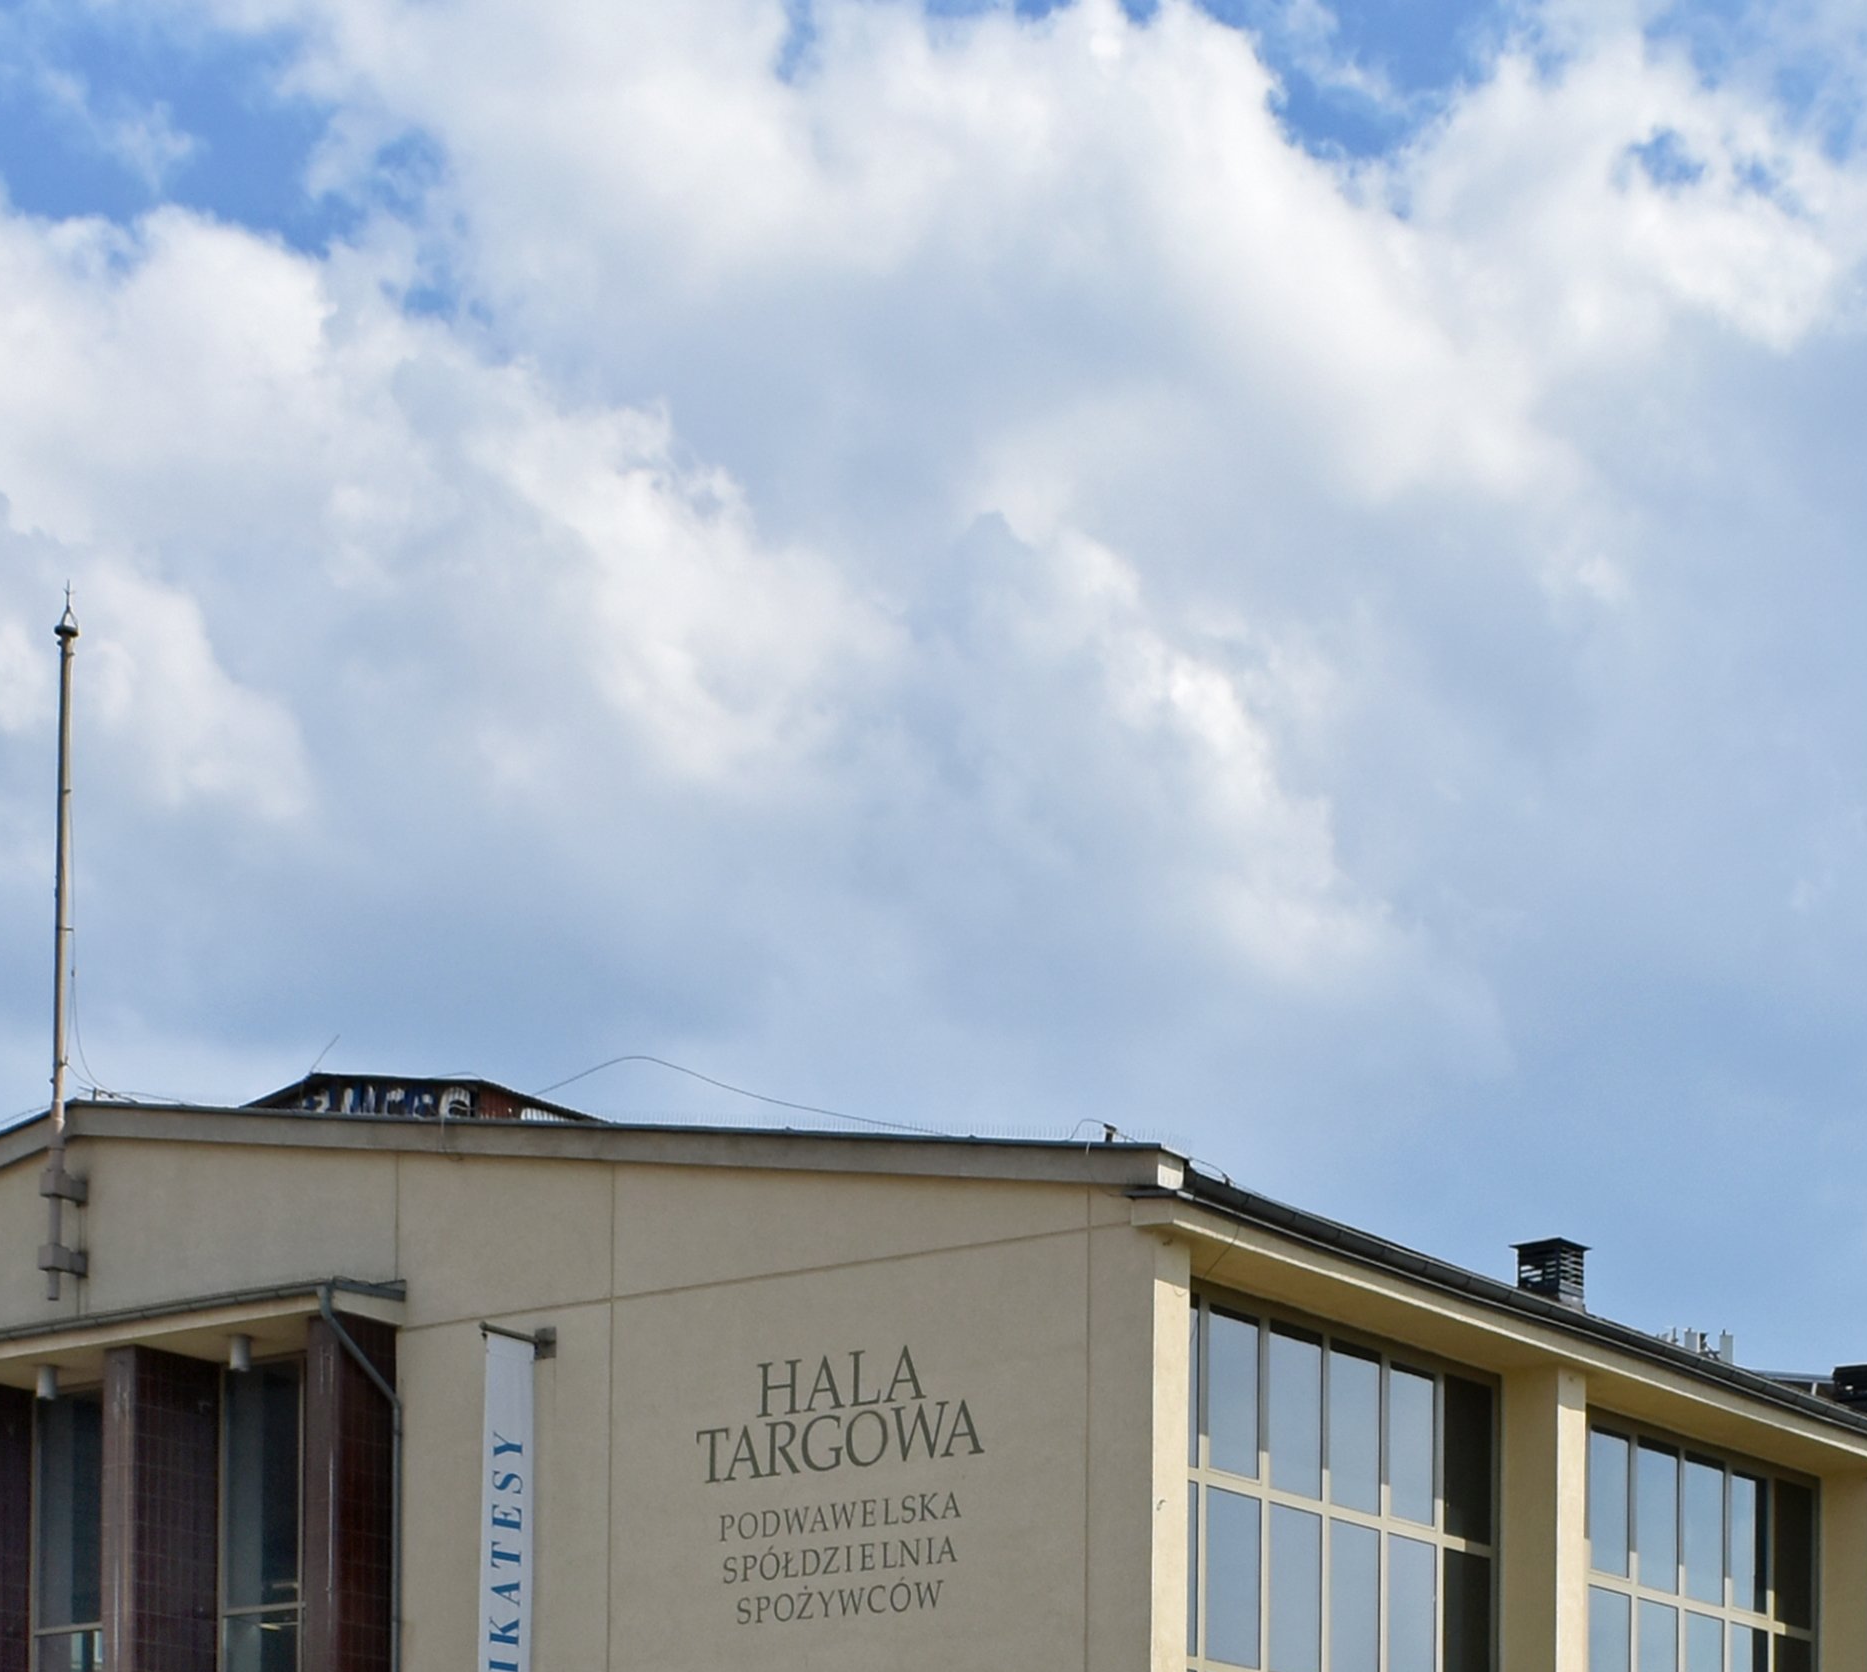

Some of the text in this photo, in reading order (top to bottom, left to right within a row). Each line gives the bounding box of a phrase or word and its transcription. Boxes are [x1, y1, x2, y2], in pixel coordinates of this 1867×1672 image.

[756, 1345, 926, 1417] HALA
[696, 1399, 985, 1483] TARGOWA
[719, 1491, 962, 1542] PODWAWELSKA
[722, 1535, 959, 1584] SPÓŁDZIELNIA
[736, 1575, 945, 1624] SPOŻYWCÓW
